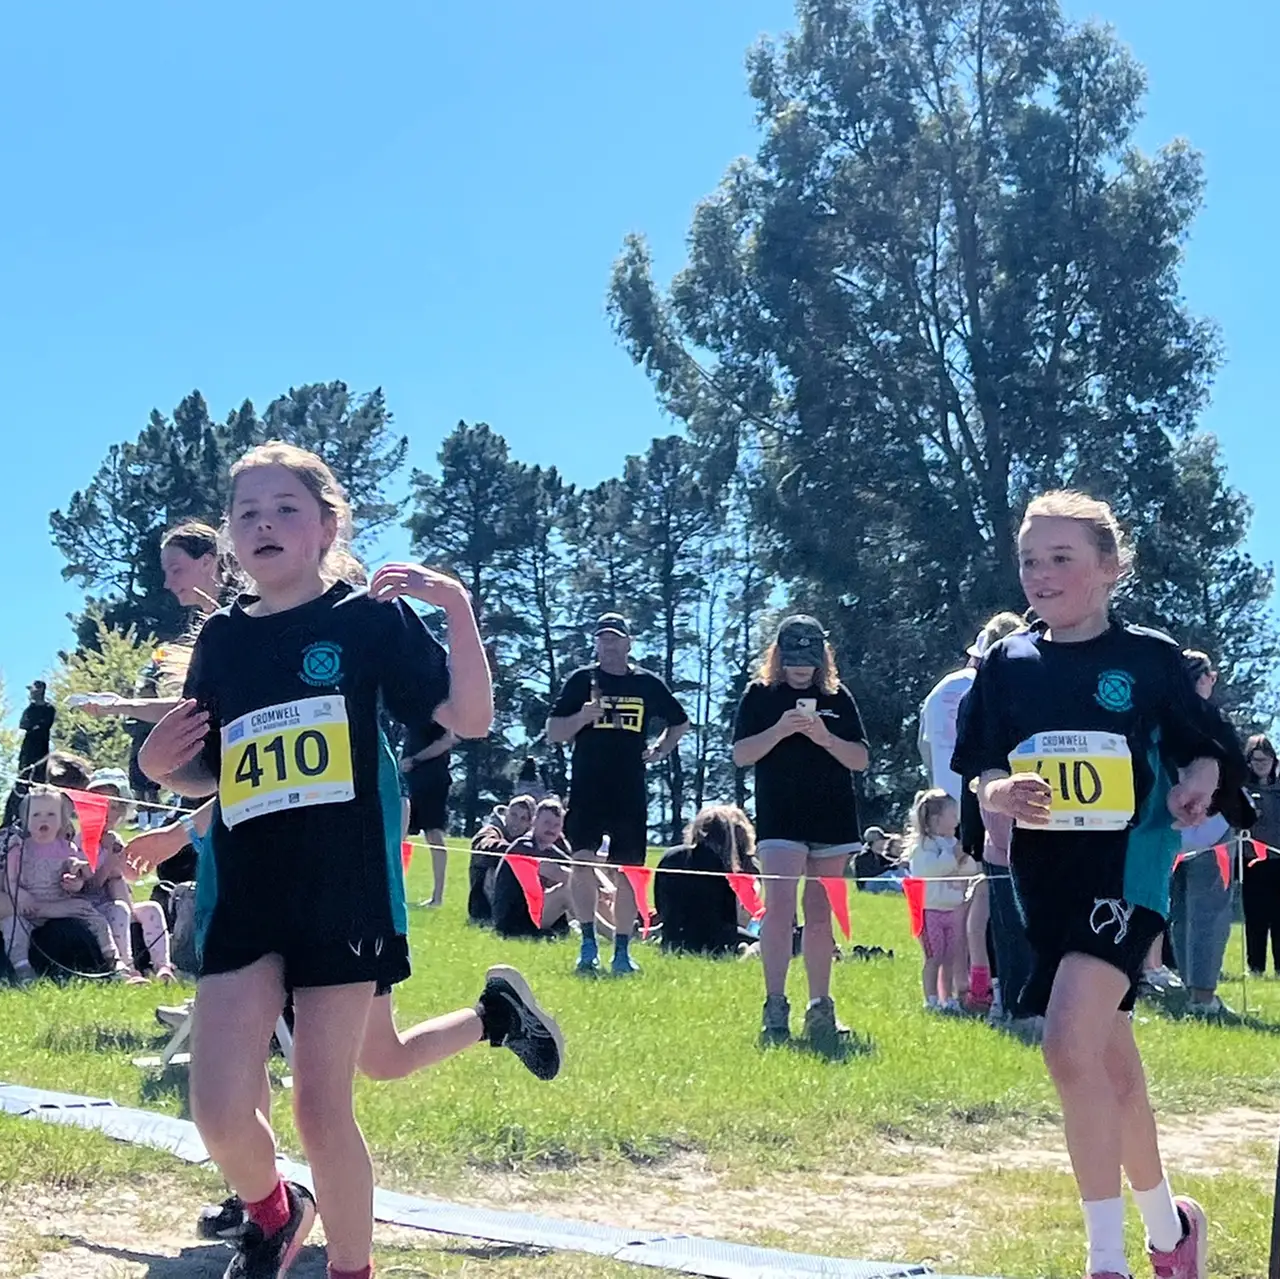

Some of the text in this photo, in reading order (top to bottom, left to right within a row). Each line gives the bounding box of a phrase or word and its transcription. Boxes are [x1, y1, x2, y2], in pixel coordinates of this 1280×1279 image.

[251, 705, 301, 727] CROMWELL
[1042, 735, 1088, 747] CROMWELL
[235, 729, 329, 788] 410
